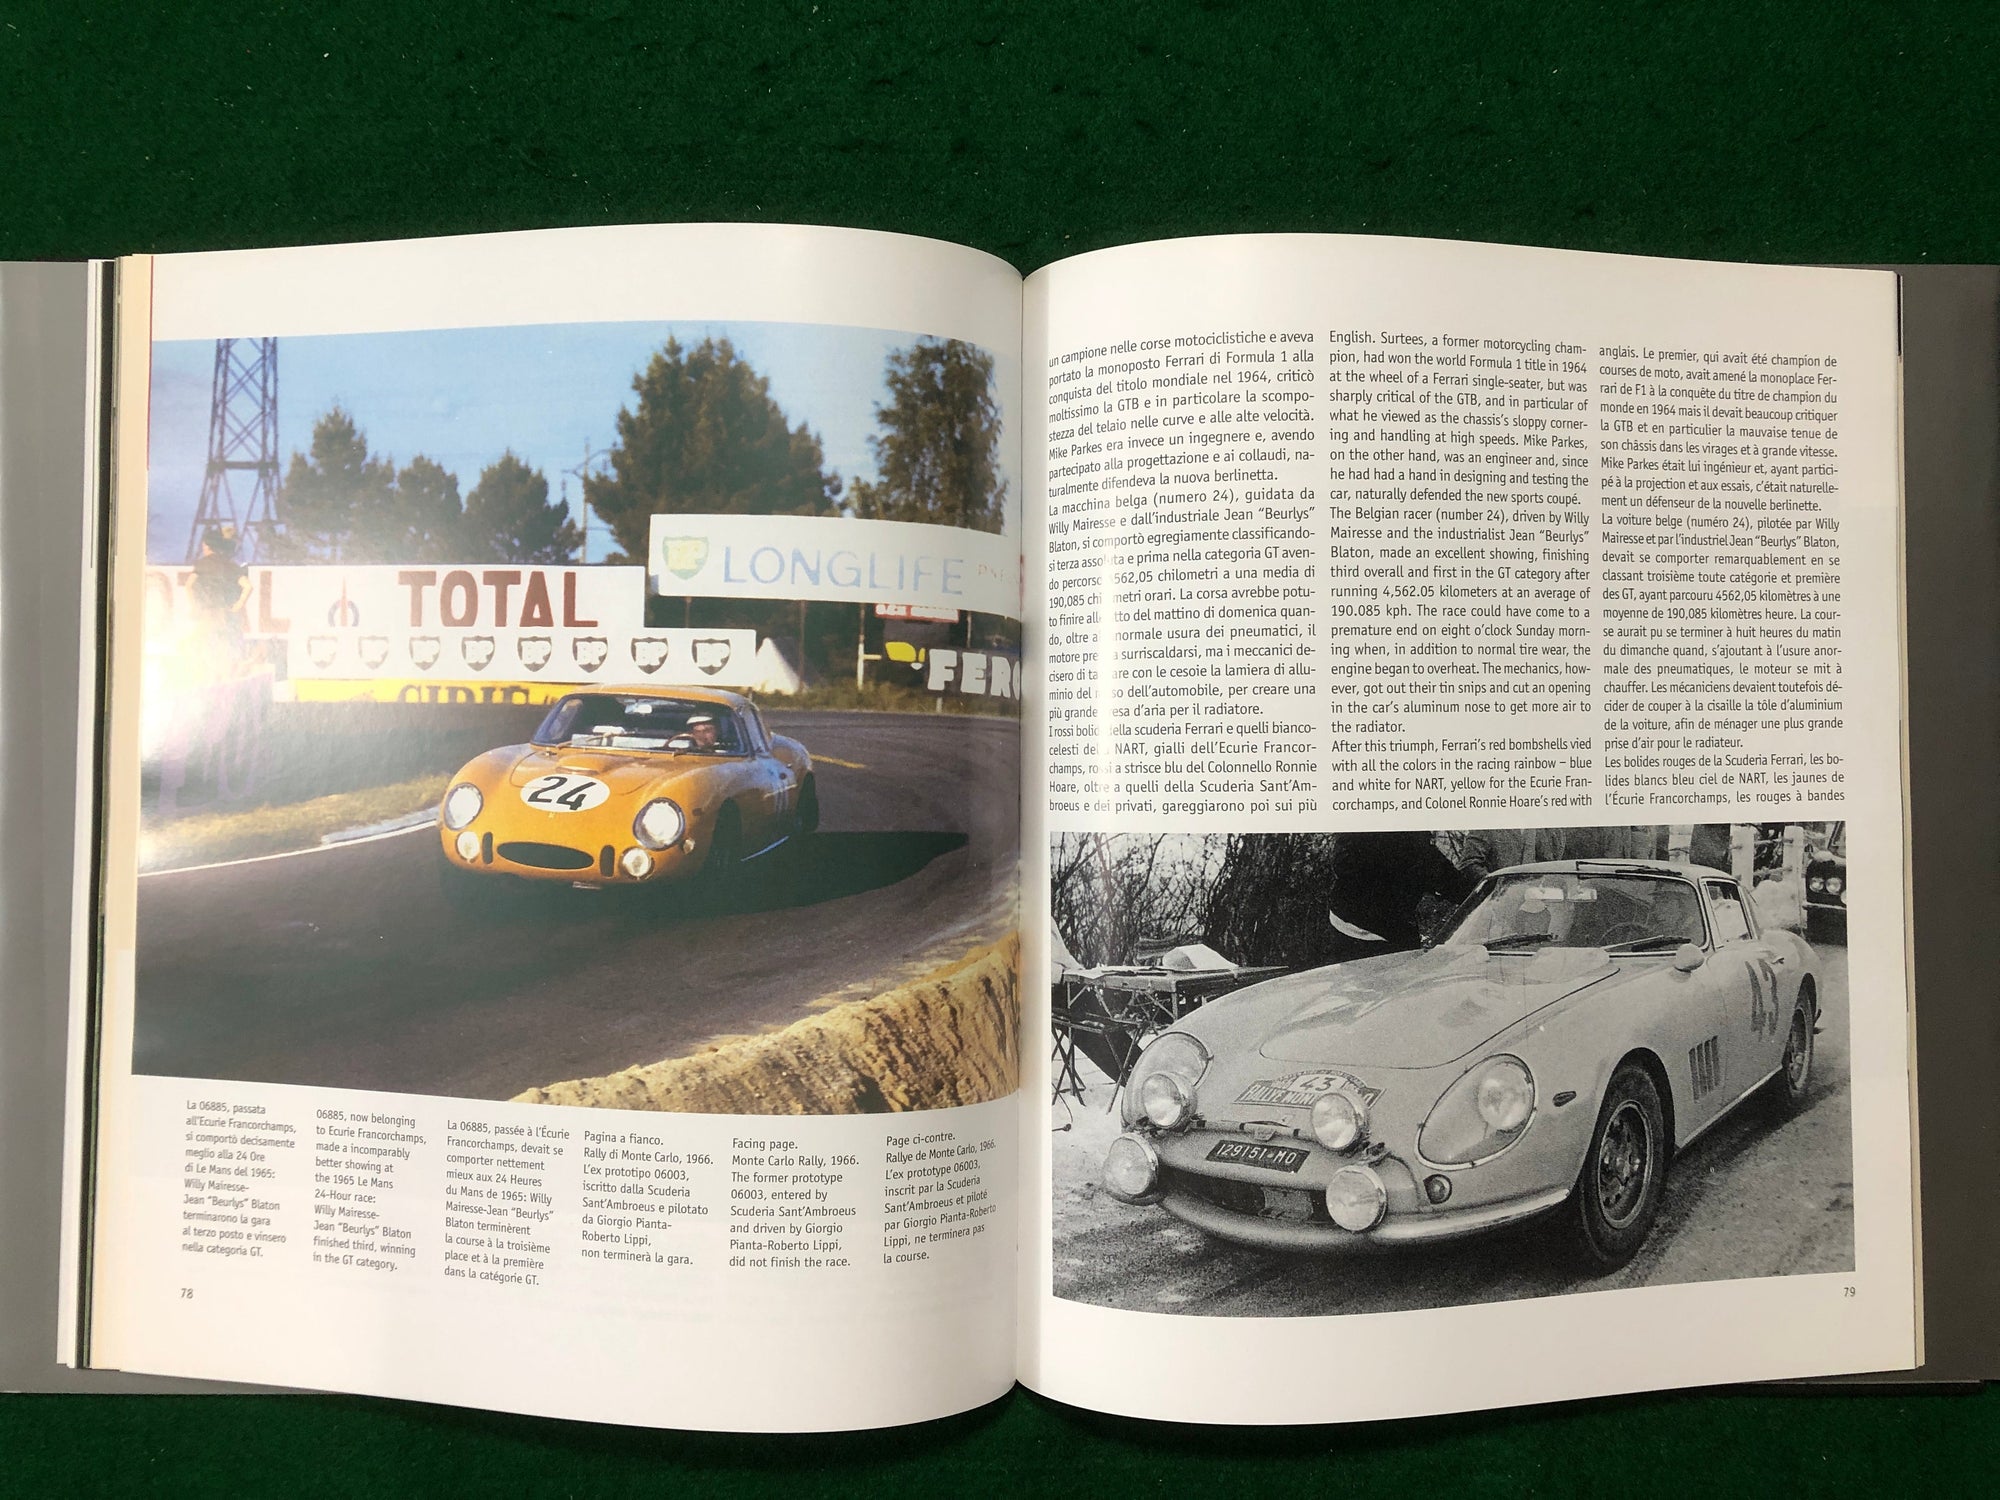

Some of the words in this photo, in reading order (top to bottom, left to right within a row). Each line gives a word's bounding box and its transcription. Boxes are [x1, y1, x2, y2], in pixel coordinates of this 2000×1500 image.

[1049, 357, 1059, 368] un
[1061, 346, 1108, 364] campione
[1110, 340, 1138, 354] nelle
[1140, 338, 1171, 351] corse
[1174, 330, 1266, 347] motociclistiche
[1269, 333, 1277, 343] e
[1280, 333, 1314, 343] aveva
[1330, 330, 1376, 346] English.
[1380, 331, 1428, 347] Surtees,
[1431, 336, 1438, 346] a
[1442, 333, 1480, 348] former
[1483, 338, 1551, 356] motorcycling
[1554, 341, 1587, 354] cham-
[1599, 345, 1639, 360] anglais.
[1643, 347, 1655, 360] Le
[1658, 349, 1700, 363] premier,
[1703, 350, 1719, 365] qui
[1722, 351, 1748, 364] avait
[1751, 352, 1768, 365] été
[1770, 353, 1820, 369] champion
[1824, 355, 1838, 368] de
[1048, 481, 1099, 498] turalmente
[1102, 474, 1156, 490] difendeva
[1160, 472, 1170, 485] la
[1174, 473, 1210, 484] nuova
[1214, 468, 1278, 482] berlinetta.
[1049, 505, 1058, 516] La
[1062, 498, 1110, 514] macchina
[1116, 494, 1147, 510] belga
[1153, 492, 1207, 508] (numero
[1213, 488, 1239, 504] 24),
[1245, 487, 1294, 504] guidata
[1300, 486, 1315, 500] da
[1330, 490, 1351, 501] car,
[1355, 487, 1407, 503] naturally
[1410, 487, 1462, 502] defended
[1464, 488, 1484, 502] the
[1486, 492, 1508, 502] new
[1511, 492, 1544, 506] sports
[1546, 492, 1581, 508] coupé.
[1329, 506, 1352, 519] The
[1355, 506, 1399, 523] Belgian
[1403, 510, 1432, 520] racer
[1436, 507, 1484, 524] (number
[1486, 508, 1509, 525] 24),
[1512, 509, 1546, 523] driven
[1549, 510, 1562, 526] by
[1564, 511, 1590, 527] Willy
[724, 546, 963, 595] LONGLIFE
[398, 570, 598, 628] TOTAL
[1331, 584, 1378, 600] running
[1382, 585, 1435, 598] 4,562.05
[1440, 584, 1498, 598] kilometers
[1501, 586, 1514, 598] at
[1516, 589, 1530, 598] an
[1534, 589, 1576, 602] average
[1579, 586, 1591, 599] of
[1603, 609, 1649, 622] moyenne
[1651, 606, 1664, 619] de
[1666, 607, 1708, 621] 190,085
[1710, 607, 1762, 620] kilomètres
[1765, 607, 1797, 620] heure.
[1800, 608, 1812, 620] La
[1814, 611, 1841, 620] cour-
[463, 638, 495, 664] BP
[519, 638, 552, 664] BP
[575, 639, 608, 666] BP
[633, 640, 669, 667] BP
[695, 642, 730, 668] BP
[1331, 720, 1352, 733] the
[1356, 720, 1406, 733] radiator.
[527, 775, 598, 812] 24
[1649, 791, 1731, 806] Francorchamps,
[1736, 790, 1751, 803] les
[1756, 792, 1792, 805] rouges
[1796, 790, 1802, 802] à
[1807, 788, 1845, 802] bandes
[1049, 799, 1080, 812] broeus
[1083, 803, 1090, 812] e
[1116, 799, 1157, 814] privati,
[1162, 799, 1245, 815] gareggiarono
[1250, 798, 1270, 814] poi
[1274, 798, 1292, 812] sui
[1298, 798, 1317, 814] più
[1332, 797, 1398, 813] corchamps,
[1401, 796, 1422, 810] and
[1425, 796, 1467, 810] Colonel
[1469, 795, 1507, 808] Ronnie
[1551, 794, 1568, 807] red
[1569, 793, 1592, 806] with
[1239, 1083, 1285, 1102] RALLYE
[1300, 1076, 1337, 1092] 43
[186, 1100, 197, 1110] La
[199, 1100, 230, 1113] 06885,
[232, 1104, 266, 1115] passata
[316, 1109, 347, 1122] 06885,
[350, 1114, 369, 1122] now
[371, 1112, 416, 1129] belonging
[447, 1135, 518, 1154] Francorchamps,
[520, 1142, 551, 1155] devait
[552, 1147, 564, 1156] se
[584, 1130, 617, 1145] Pagina
[620, 1135, 626, 1143] a
[629, 1132, 664, 1146] fianco.
[732, 1138, 766, 1152] Facing
[769, 1140, 798, 1152] page.
[886, 1136, 910, 1149] Page
[912, 1132, 956, 1145] ci-contre.
[184, 1178, 206, 1192] Willy
[208, 1180, 250, 1192] Mairesse-
[314, 1188, 352, 1201] 24-Hour
[354, 1194, 376, 1204] race:
[730, 1205, 775, 1217] Scuderia
[582, 1230, 621, 1244] Roberto
[624, 1233, 652, 1248] Lippi,
[884, 1232, 911, 1249] Lippi,
[914, 1230, 927, 1244] ne
[928, 1228, 970, 1242] terminera
[972, 1224, 985, 1236] pas
[182, 1241, 204, 1253] nella
[206, 1244, 248, 1257] categoria
[250, 1246, 264, 1257] GT.
[313, 1235, 350, 1249] finished
[352, 1240, 377, 1253] third,
[380, 1242, 416, 1259] winning
[729, 1256, 746, 1267] did
[749, 1258, 768, 1268] not
[770, 1256, 800, 1268] finish
[804, 1256, 822, 1268] the
[826, 1258, 851, 1267] race.
[883, 1253, 892, 1264] la
[895, 1251, 930, 1263] course.
[444, 1265, 466, 1278] dans
[468, 1267, 477, 1279] la
[479, 1270, 523, 1284] catégorie
[525, 1274, 539, 1286] GT.
[181, 1288, 194, 1299] 78
[1843, 1286, 1857, 1298] 79
